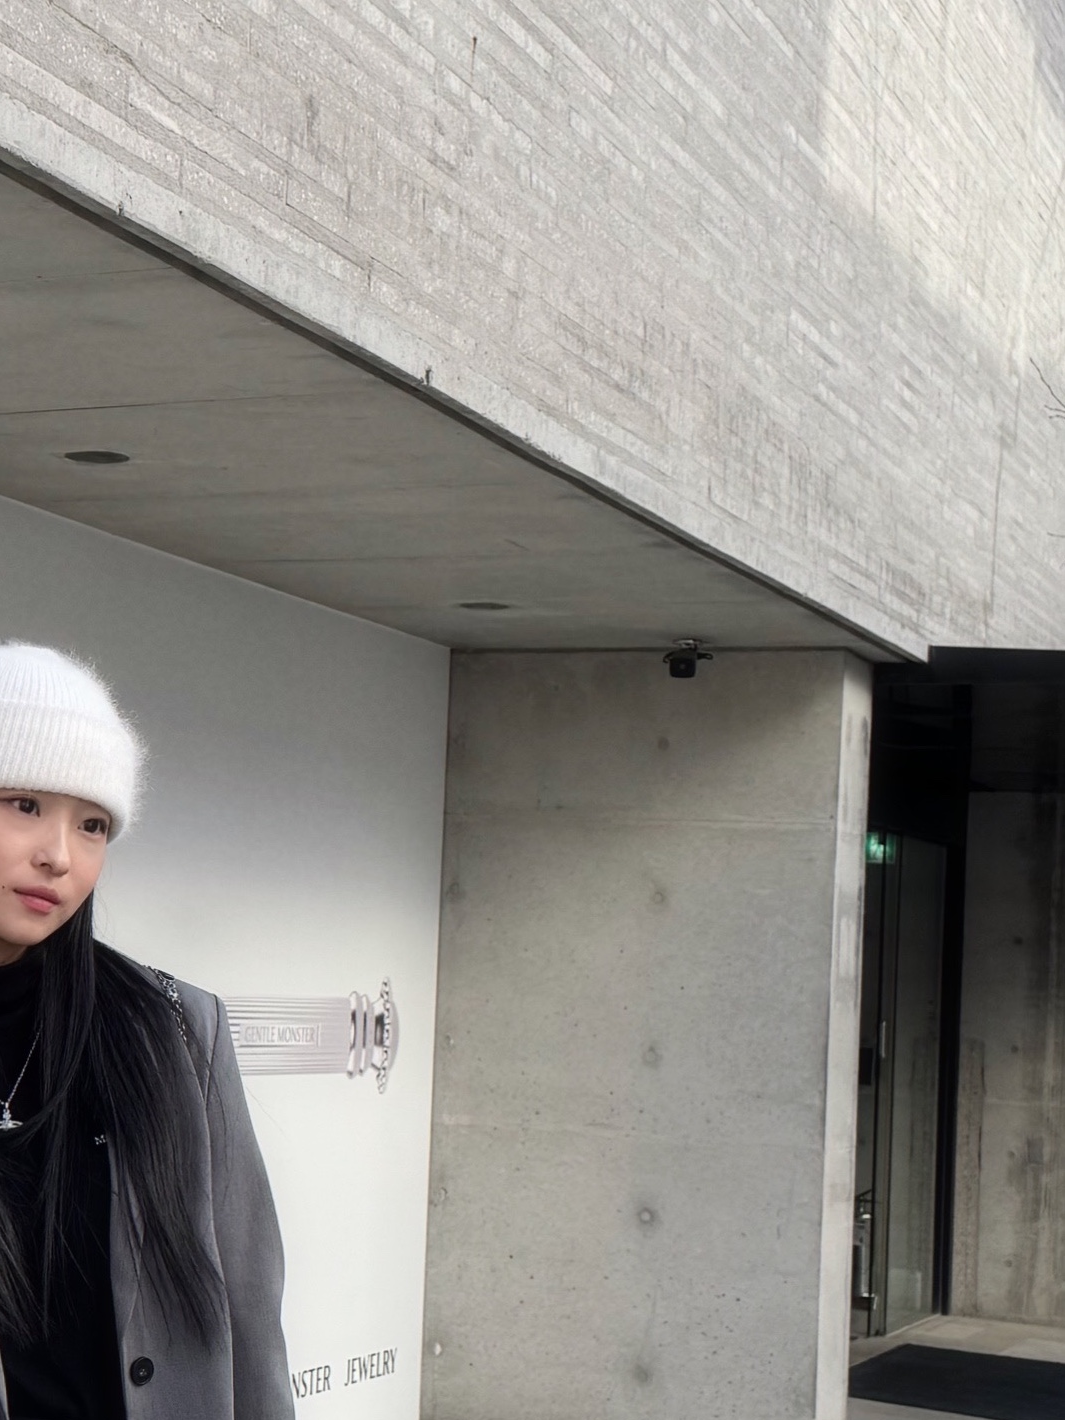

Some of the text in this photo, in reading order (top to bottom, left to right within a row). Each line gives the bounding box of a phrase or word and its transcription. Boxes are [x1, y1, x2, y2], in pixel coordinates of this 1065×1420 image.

[244, 1025, 315, 1043] GENTLE MONSTER
[291, 1347, 398, 1399] NSTER JEWELRY
